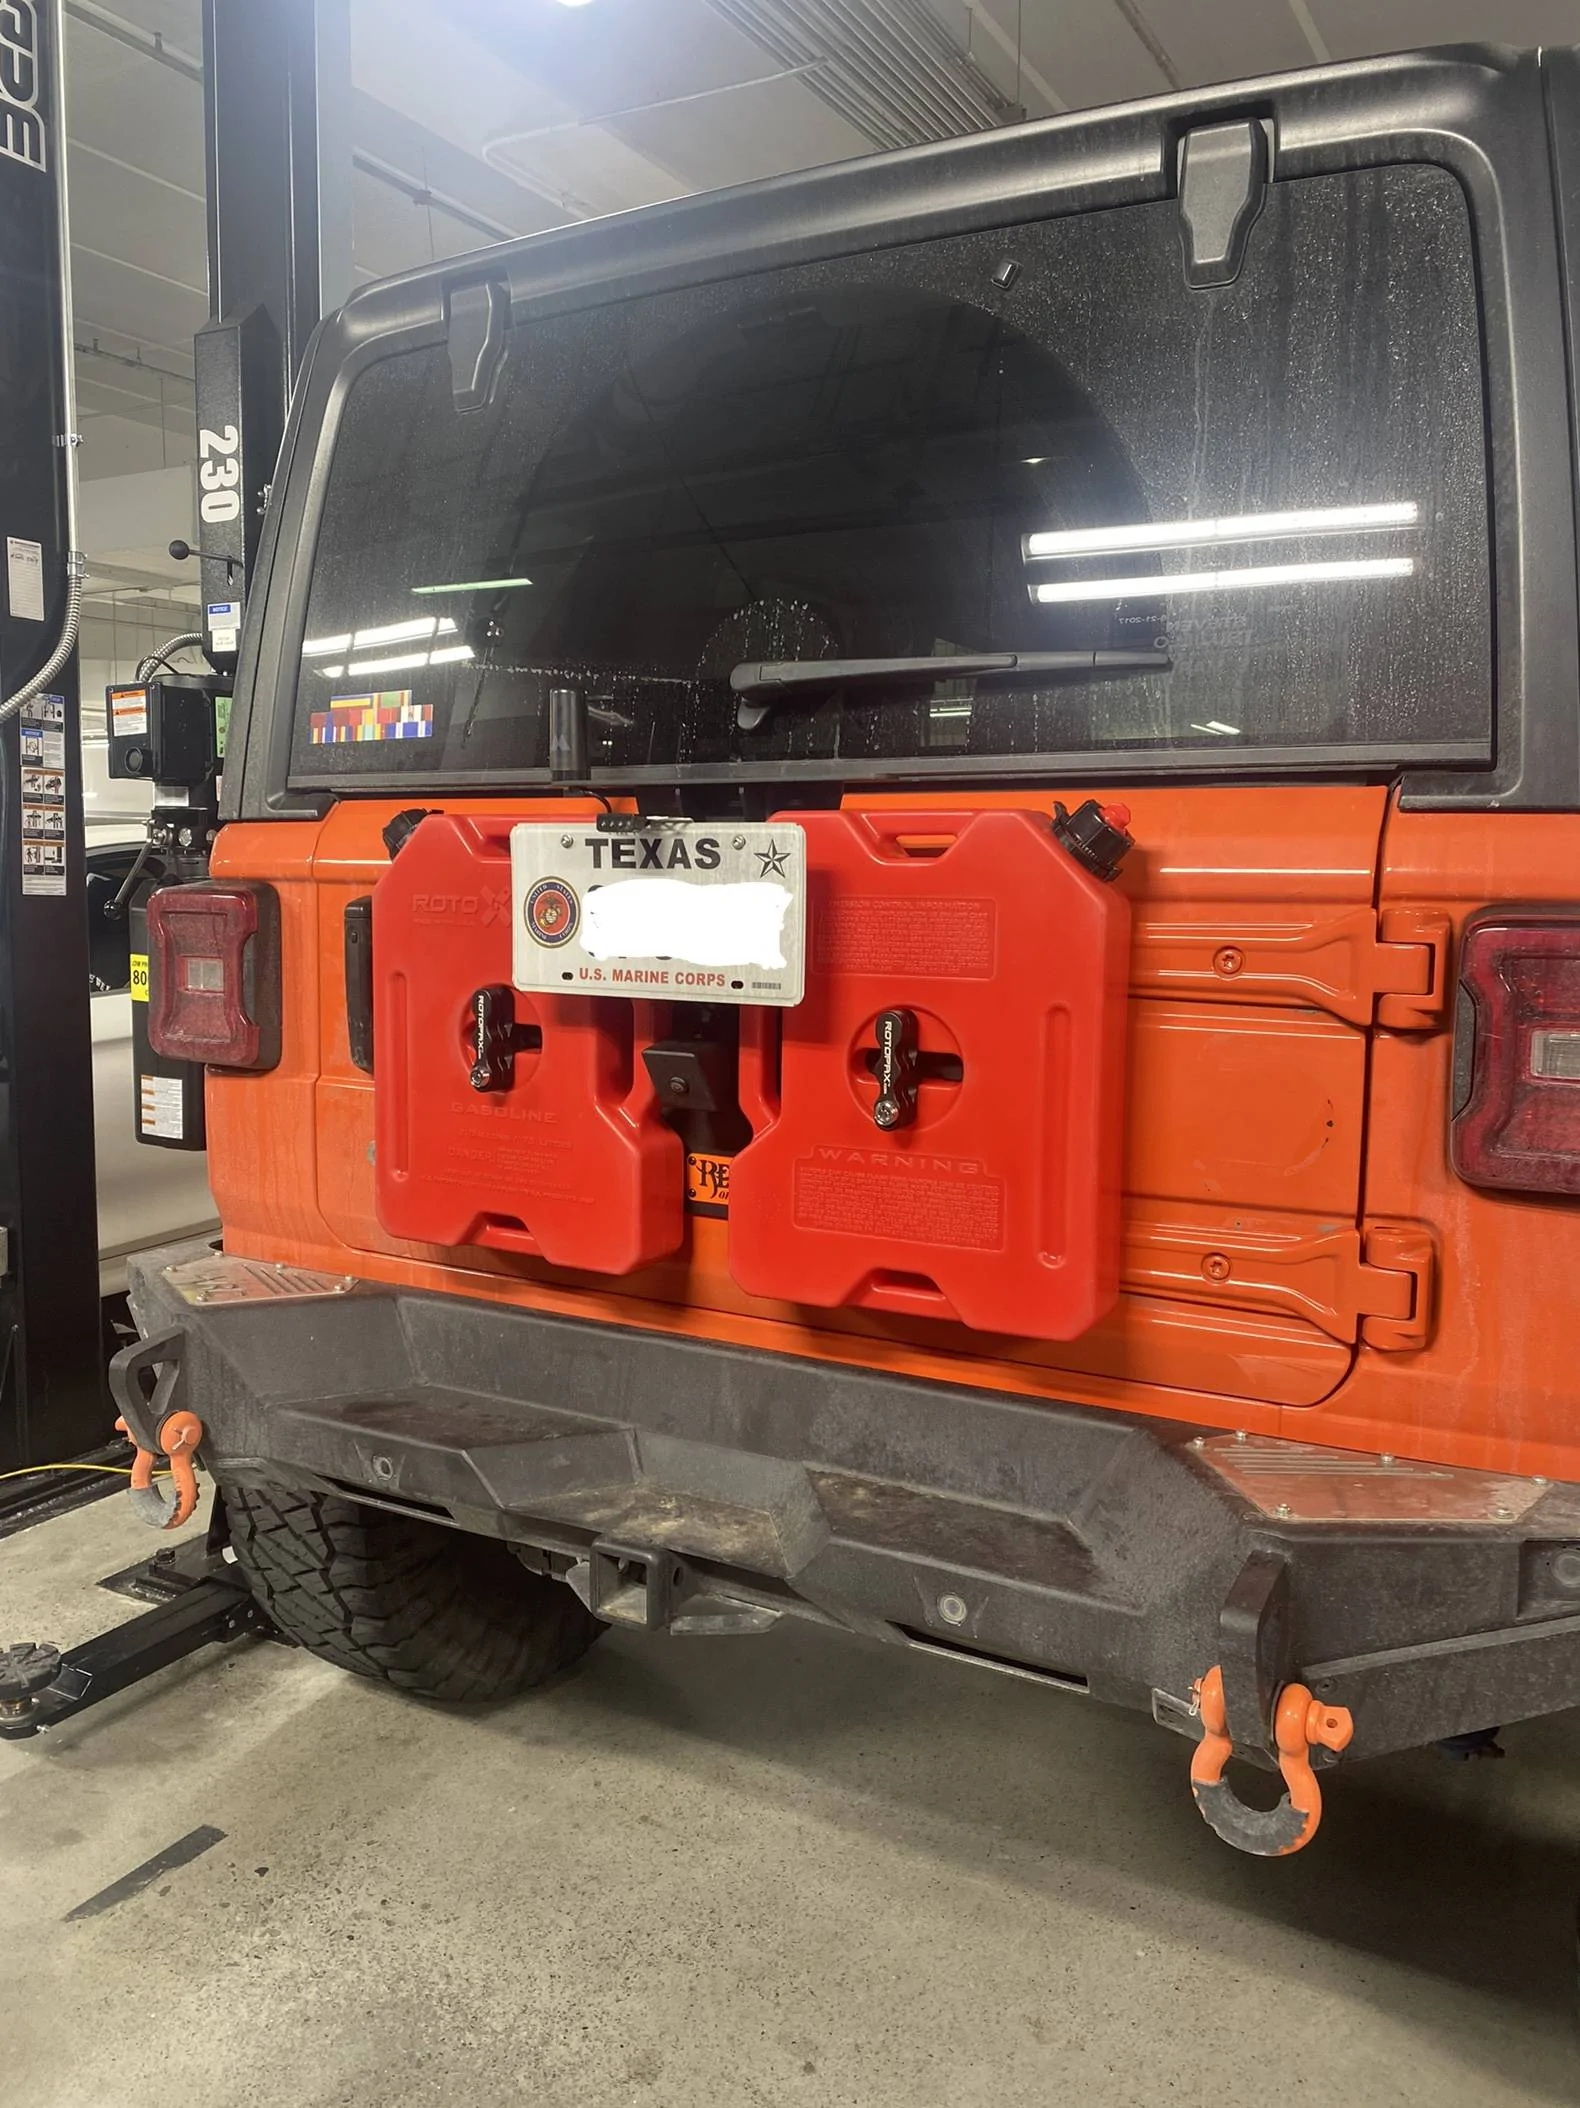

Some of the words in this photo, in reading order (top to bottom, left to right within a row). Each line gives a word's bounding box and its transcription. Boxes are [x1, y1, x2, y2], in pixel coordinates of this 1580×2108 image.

[199, 425, 241, 523] 230
[585, 838, 721, 869] TEXAS
[579, 967, 606, 981] U.S.
[612, 969, 669, 984] MARINE
[675, 972, 726, 987] CORPS
[884, 1021, 893, 1083] ROTOPAX
[450, 1101, 559, 1125] GASOLINE
[818, 1148, 980, 1175] WARNING
